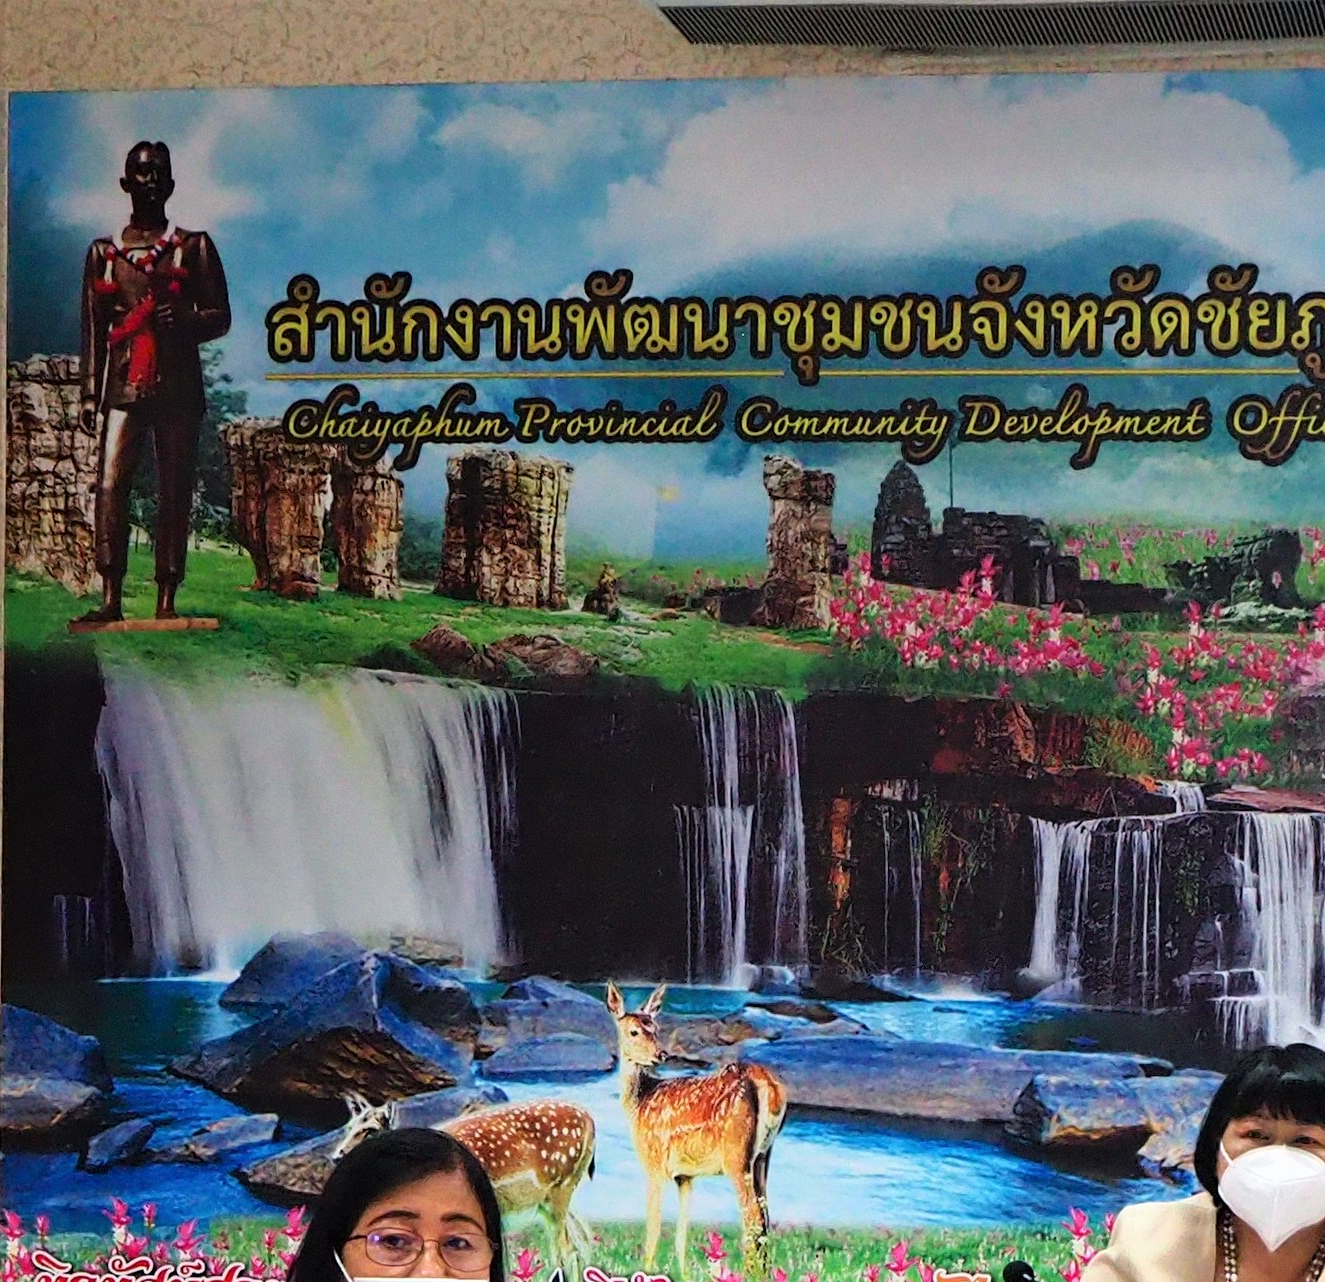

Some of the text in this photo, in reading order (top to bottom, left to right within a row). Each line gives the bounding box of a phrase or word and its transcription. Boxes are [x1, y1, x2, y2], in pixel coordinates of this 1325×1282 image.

[286, 385, 511, 469] Chaiyaphum
[517, 388, 725, 440] Provincial
[738, 398, 951, 462] Community
[962, 386, 1209, 466] Development
